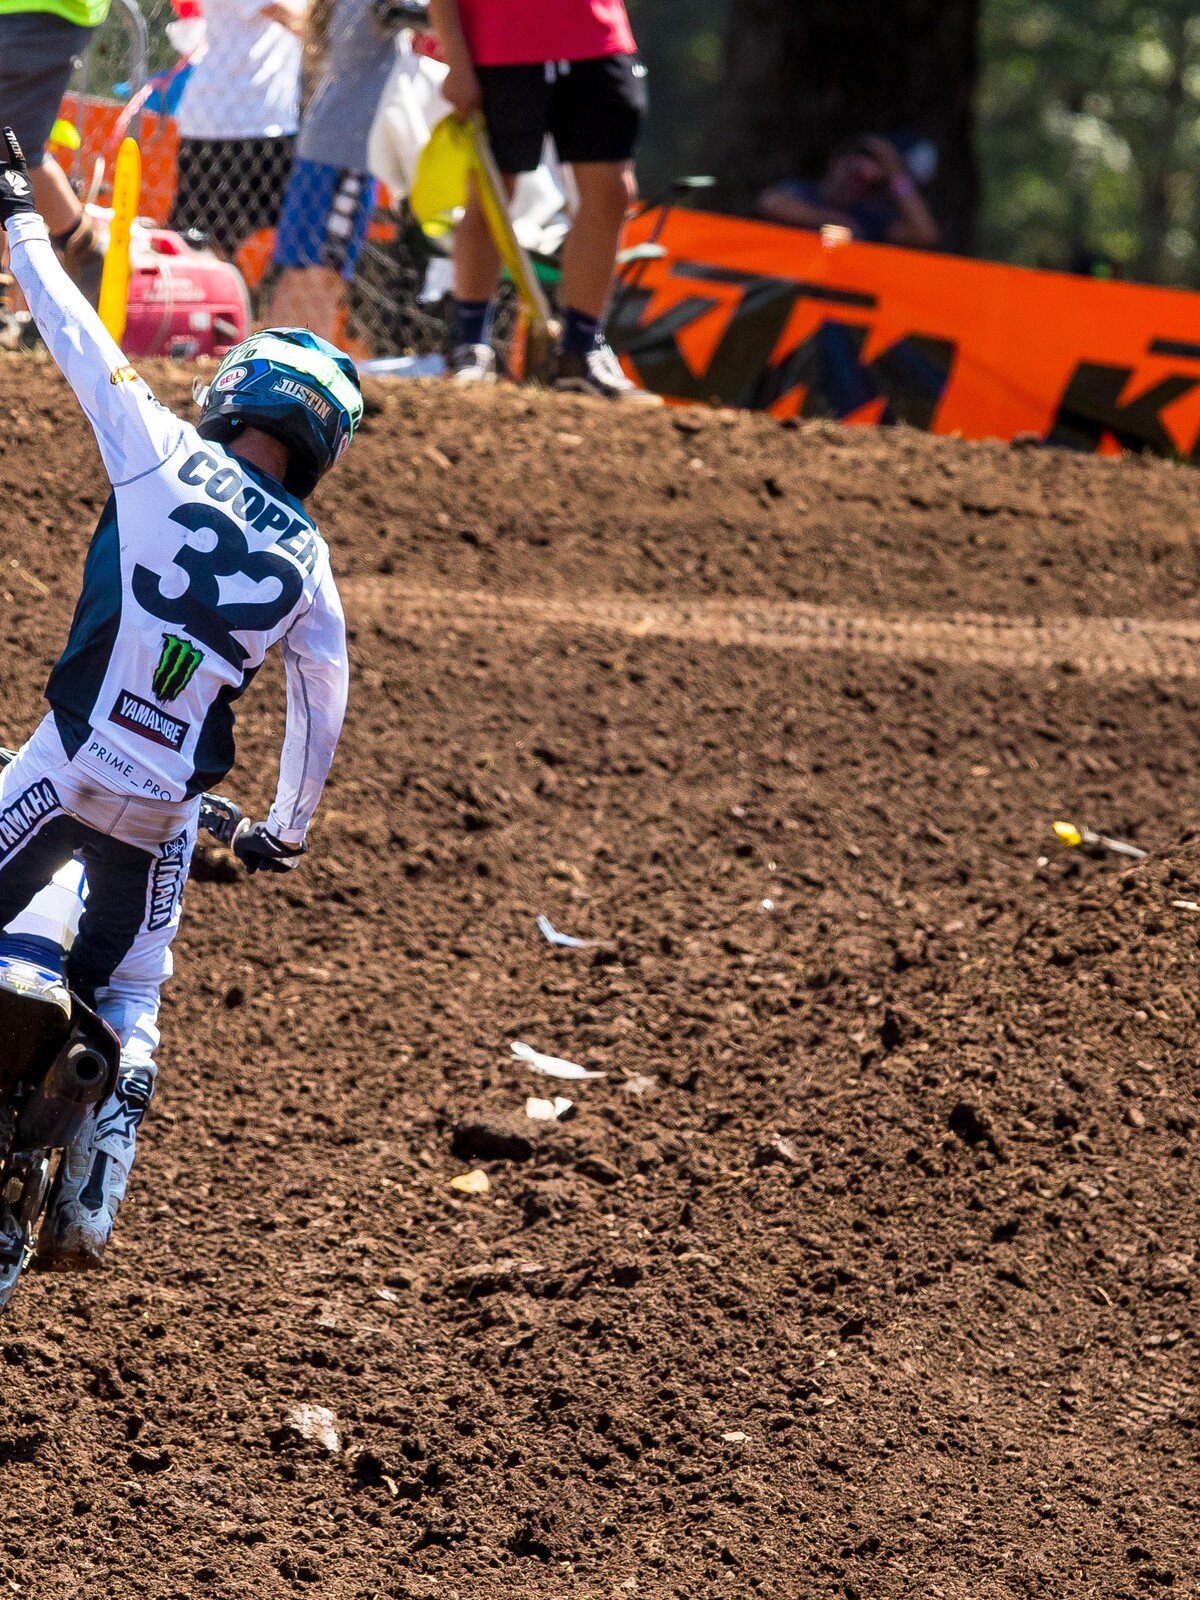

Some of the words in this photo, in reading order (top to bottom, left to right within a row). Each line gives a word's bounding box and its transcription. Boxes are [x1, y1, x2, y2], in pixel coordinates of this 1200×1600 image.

[219, 371, 242, 387] BELL
[603, 259, 959, 430] KTM
[274, 378, 332, 420] JUSTIN
[177, 451, 319, 580] COOPER
[131, 502, 304, 674] 32
[119, 698, 184, 747] YAMALUBE
